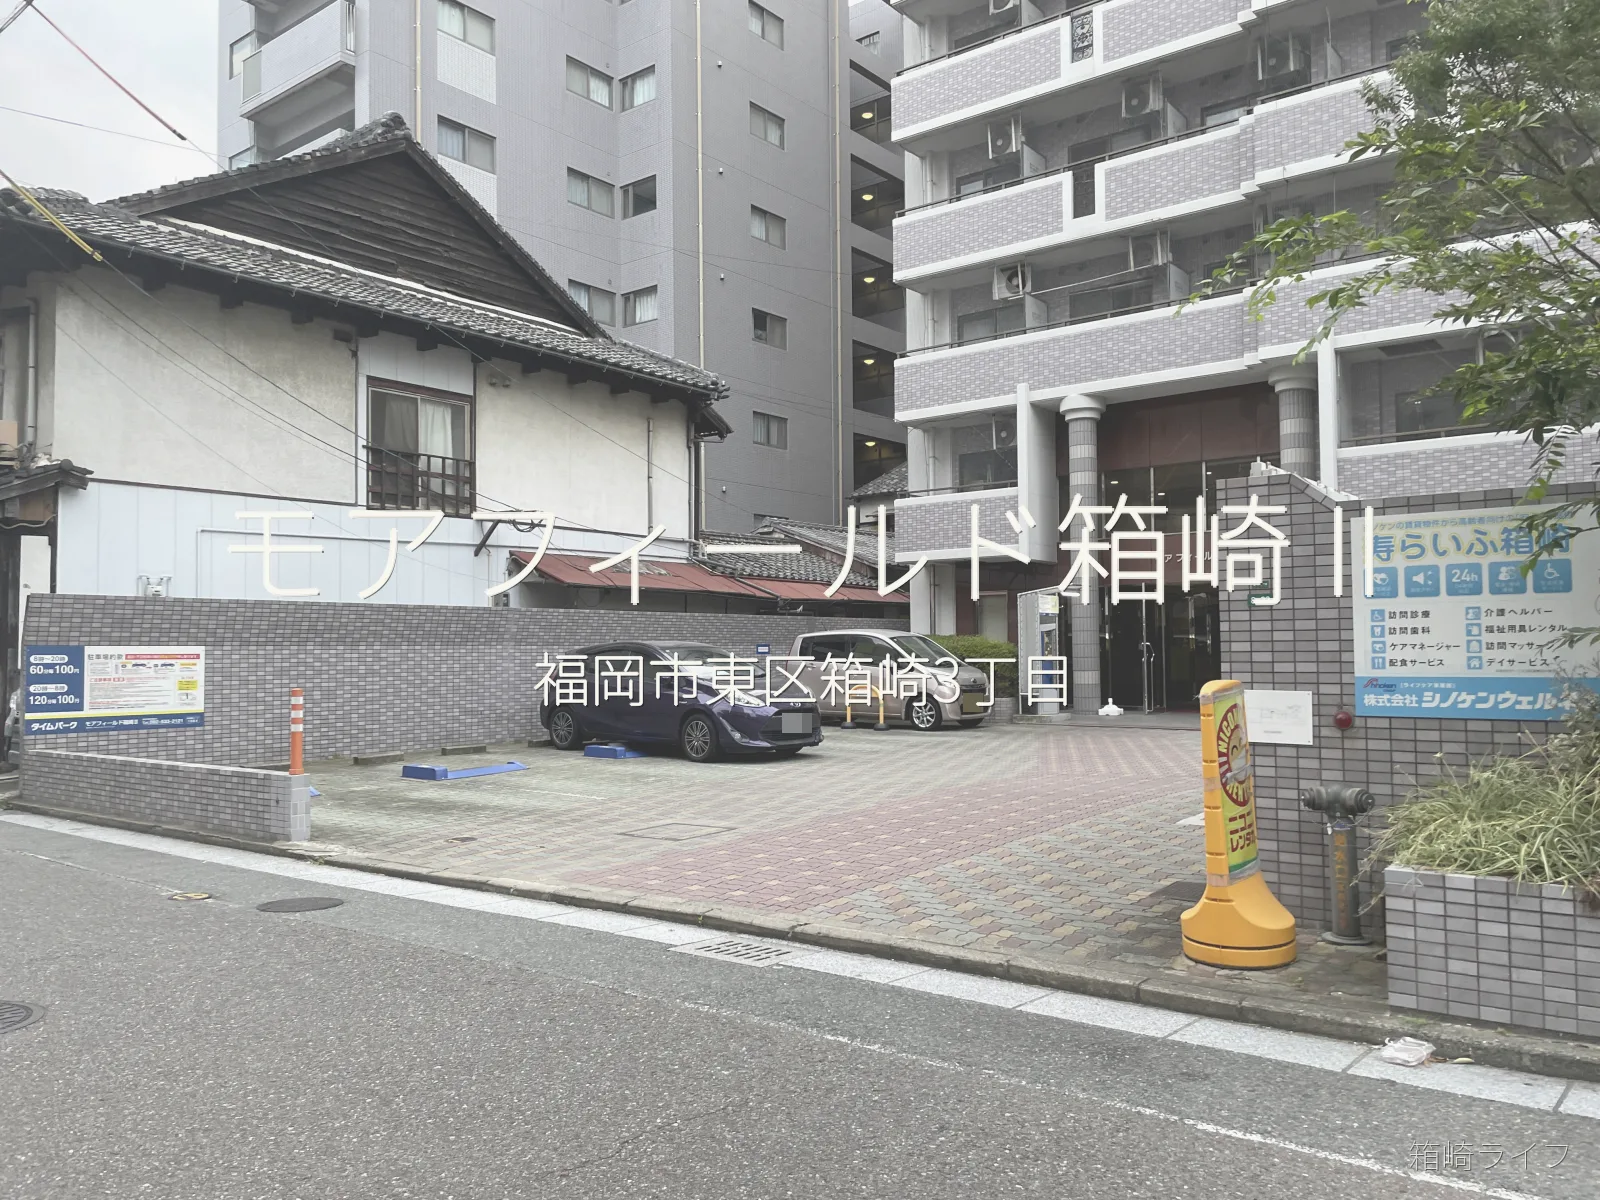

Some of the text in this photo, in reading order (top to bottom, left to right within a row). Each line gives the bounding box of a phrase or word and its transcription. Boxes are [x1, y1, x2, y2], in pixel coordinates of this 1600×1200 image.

[1451, 568, 1478, 583] 24h
[1388, 610, 1430, 620] 訪問診療
[1388, 626, 1430, 635] 訪問歯科
[1484, 624, 1567, 634] 福祉用具レンタル
[1389, 641, 1461, 651] ケアマネージャー
[1388, 658, 1445, 667] 配食サービス
[1486, 658, 1550, 667] デイサービス
[31, 721, 78, 731] タイムパーク
